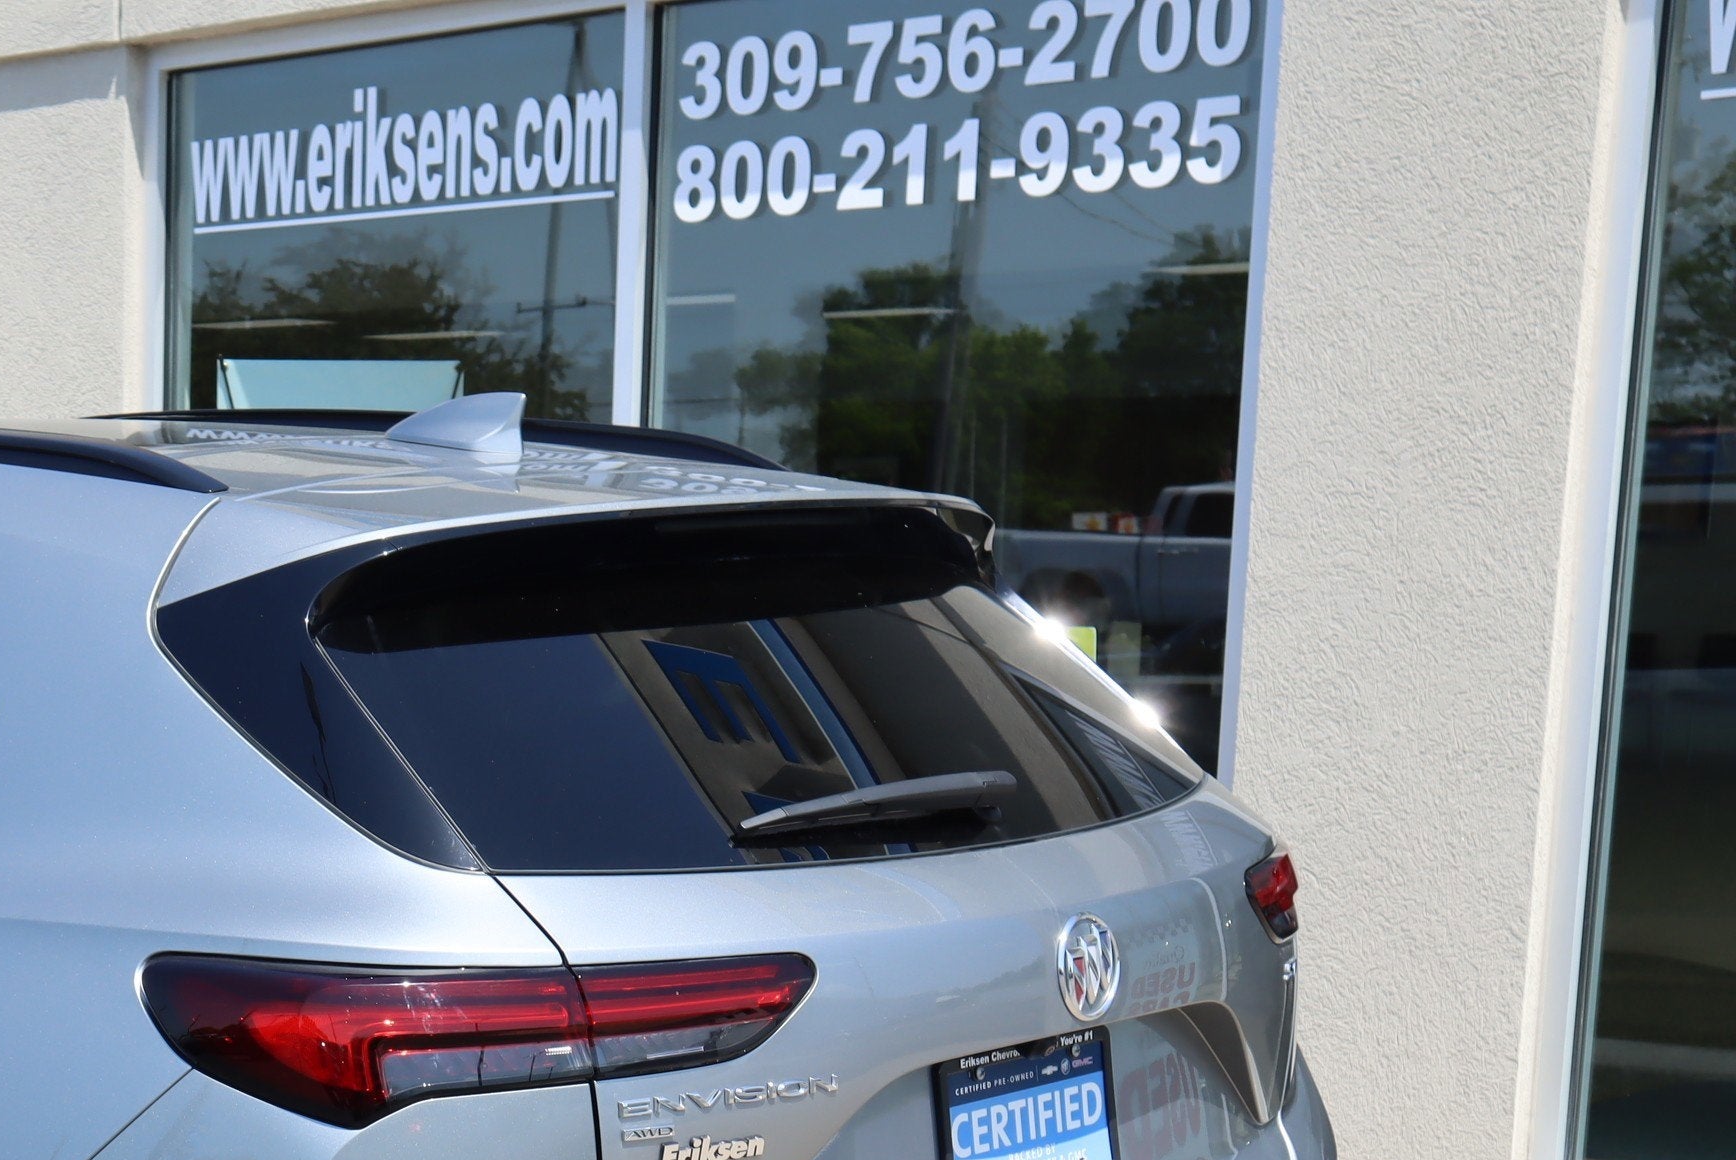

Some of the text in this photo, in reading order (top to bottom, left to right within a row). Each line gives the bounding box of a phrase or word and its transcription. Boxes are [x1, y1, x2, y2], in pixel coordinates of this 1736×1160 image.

[679, 0, 1252, 120] 309-756-2700
[191, 86, 619, 225] www.eriksens.com
[673, 95, 1243, 223] 800-211-9335
[1060, 1033, 1083, 1047] You're
[960, 1049, 1021, 1069] Eriksen Chevro
[1072, 1056, 1093, 1068] GMC
[618, 1073, 840, 1118] ENVISION
[955, 1070, 1034, 1096] CERTIFIED PRE-OWNED
[625, 1125, 674, 1140] AWD
[951, 1081, 1103, 1159] CERTIFIED
